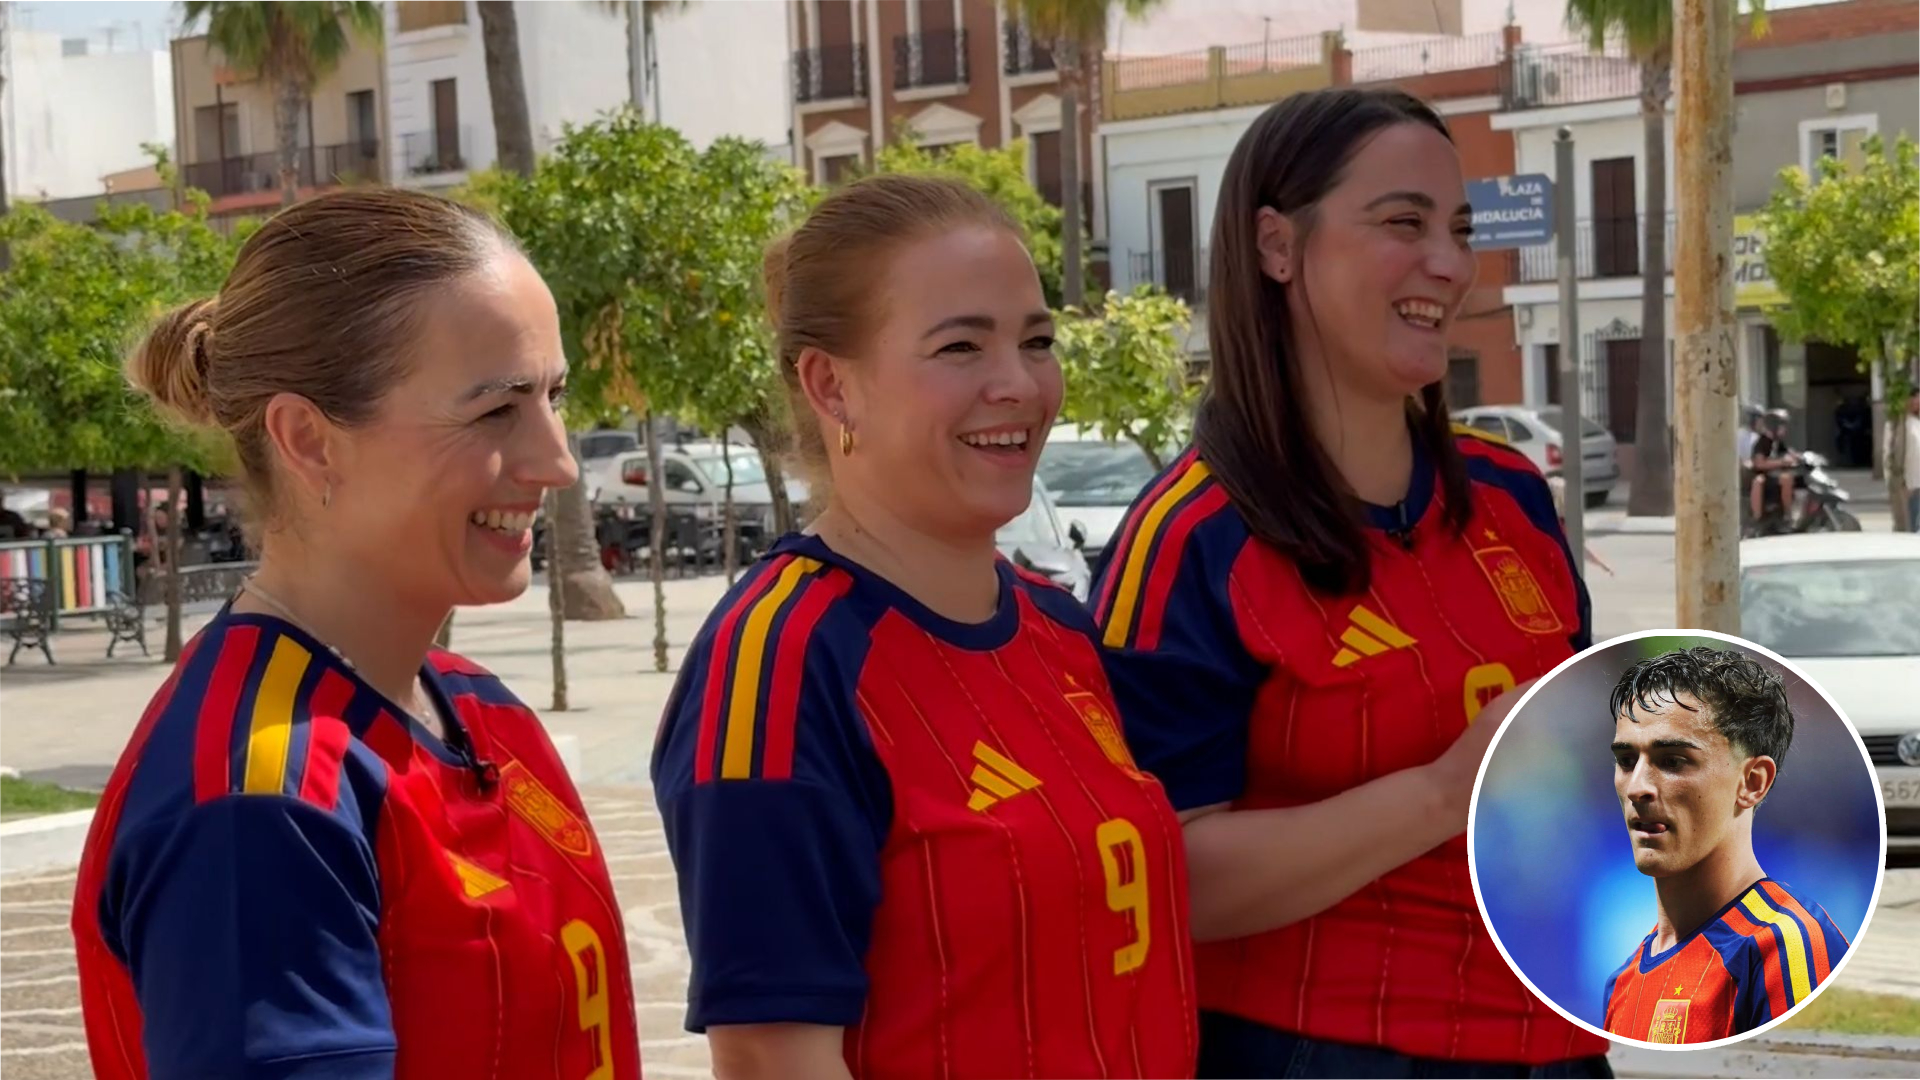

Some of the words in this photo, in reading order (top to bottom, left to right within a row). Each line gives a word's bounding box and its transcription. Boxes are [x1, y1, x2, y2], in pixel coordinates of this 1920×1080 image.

[1500, 182, 1543, 197] PLAZA
[1471, 206, 1544, 224] NDALUCIA
[1096, 818, 1150, 977] 9
